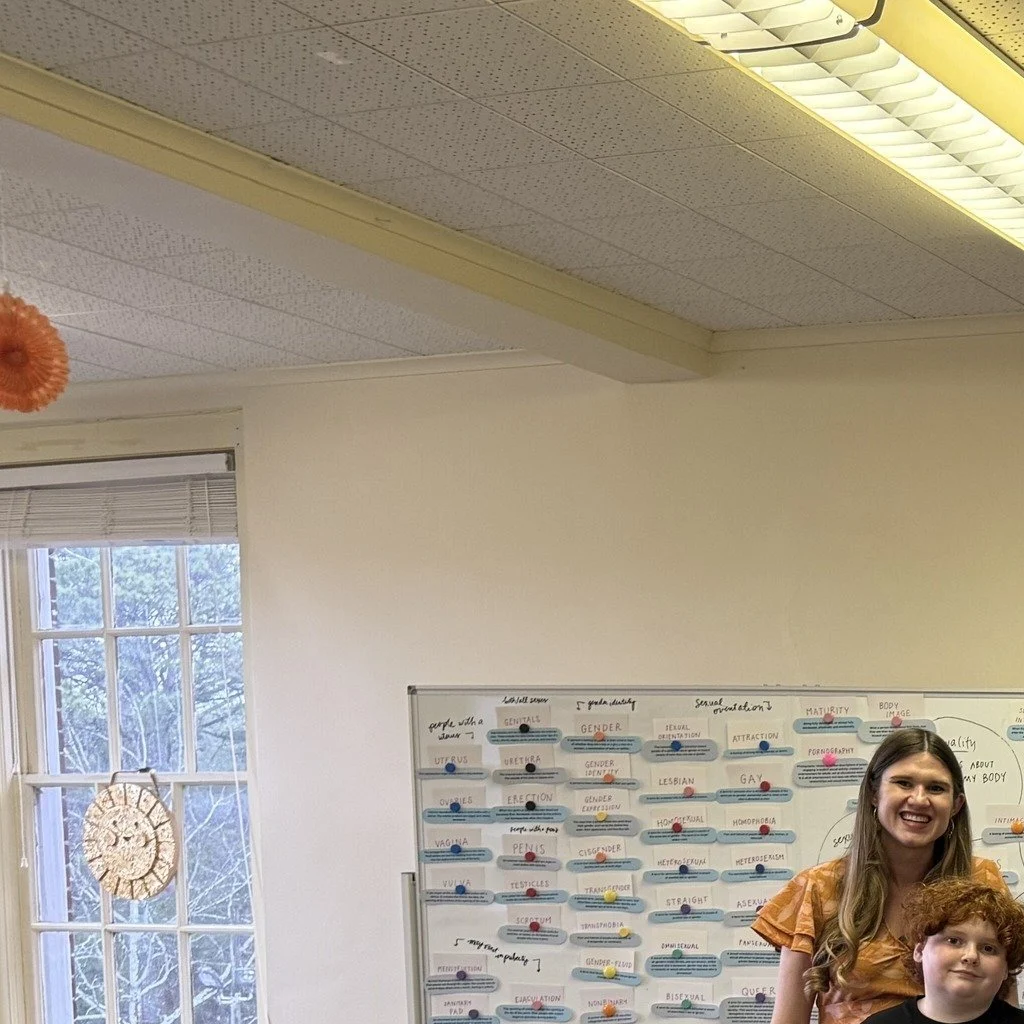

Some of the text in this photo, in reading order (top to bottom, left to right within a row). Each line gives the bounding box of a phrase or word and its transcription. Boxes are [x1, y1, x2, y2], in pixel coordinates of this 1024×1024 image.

[879, 701, 899, 709] BODY
[806, 706, 849, 715] MATURITY
[886, 709, 911, 718] IMAGE
[580, 722, 622, 733] GENDER
[665, 723, 690, 731] SEXUAL
[658, 731, 701, 740] ORIENTATION
[732, 732, 779, 742] ATTRACTION
[808, 747, 854, 756] PORNOGRAPHY
[434, 755, 468, 764] UTERUS
[504, 755, 541, 766] URETHRA
[970, 760, 994, 770] ABOUT
[658, 777, 695, 786] LESBIAN
[740, 773, 763, 785] GAY
[982, 771, 1006, 783] BODY
[507, 792, 554, 804] ERECTION
[584, 795, 613, 803] GENDER
[732, 816, 777, 826] HOMOPHOBIA
[434, 838, 469, 847] VAGINA
[512, 842, 546, 854] PENIS
[578, 844, 622, 857] CISGENDER
[510, 880, 551, 889] TESTICLES
[666, 895, 709, 906] STRAIGHT
[580, 920, 625, 930] TRANSPHOBIA
[666, 992, 706, 1001] BISEXUAL
[741, 986, 776, 997] QUEER
